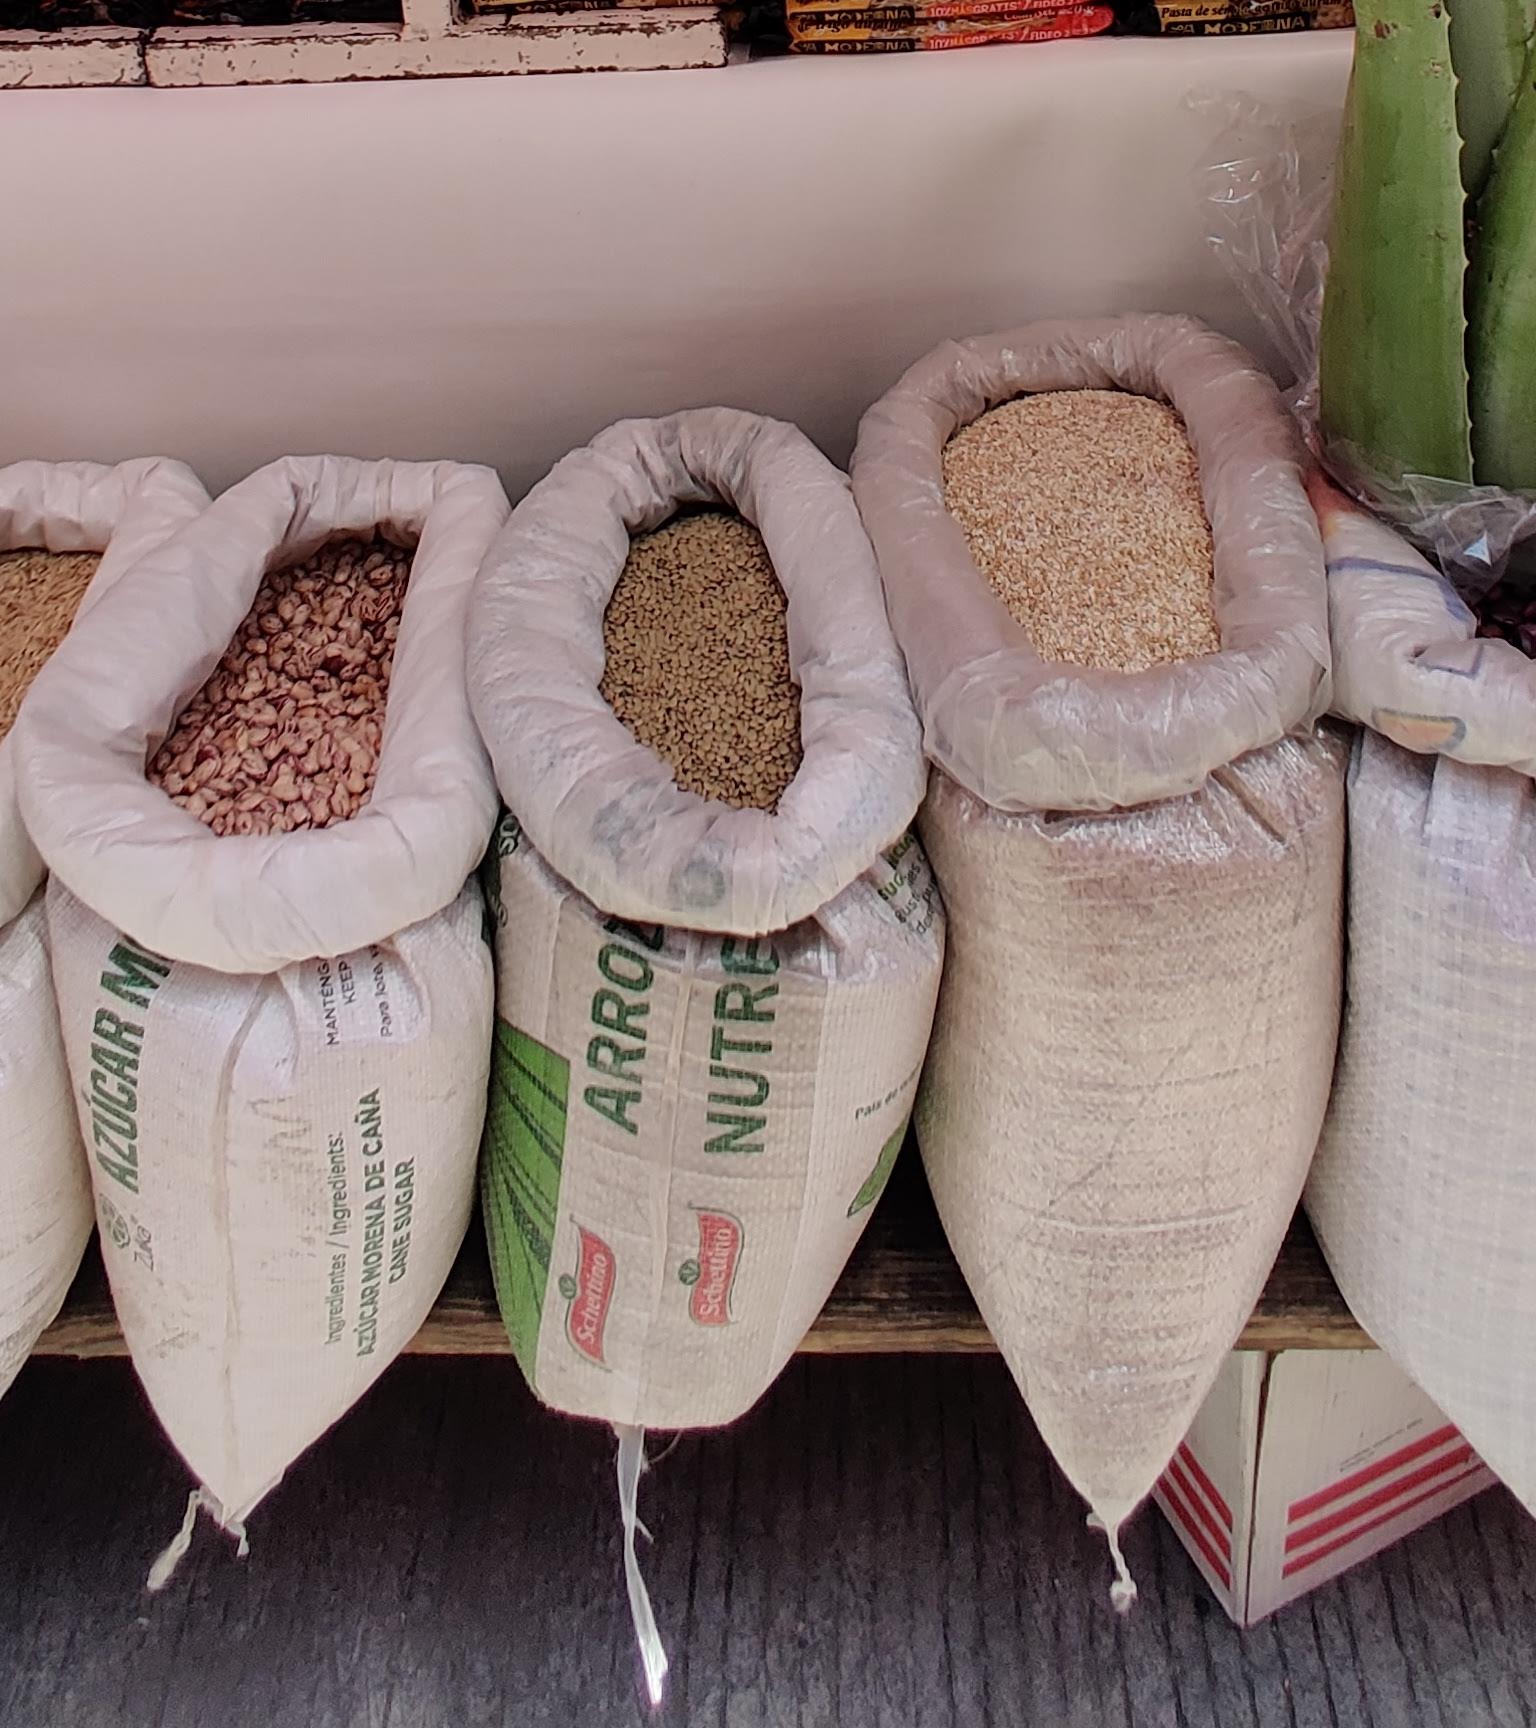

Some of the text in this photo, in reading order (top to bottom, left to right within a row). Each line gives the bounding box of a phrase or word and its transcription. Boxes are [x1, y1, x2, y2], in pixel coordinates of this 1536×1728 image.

[339, 960, 356, 1006] KEEP
[380, 1006, 395, 1038] Para
[84, 1007, 146, 1195] AZÚCAR
[324, 1131, 352, 1348] Ingredientes Ingredients:
[354, 1088, 386, 1359] AZÚCAR MORENA DE CAÑA
[388, 1155, 416, 1283] CANE SUGAR
[699, 1227, 733, 1319] Schettino
[576, 1251, 608, 1346] Schettino
